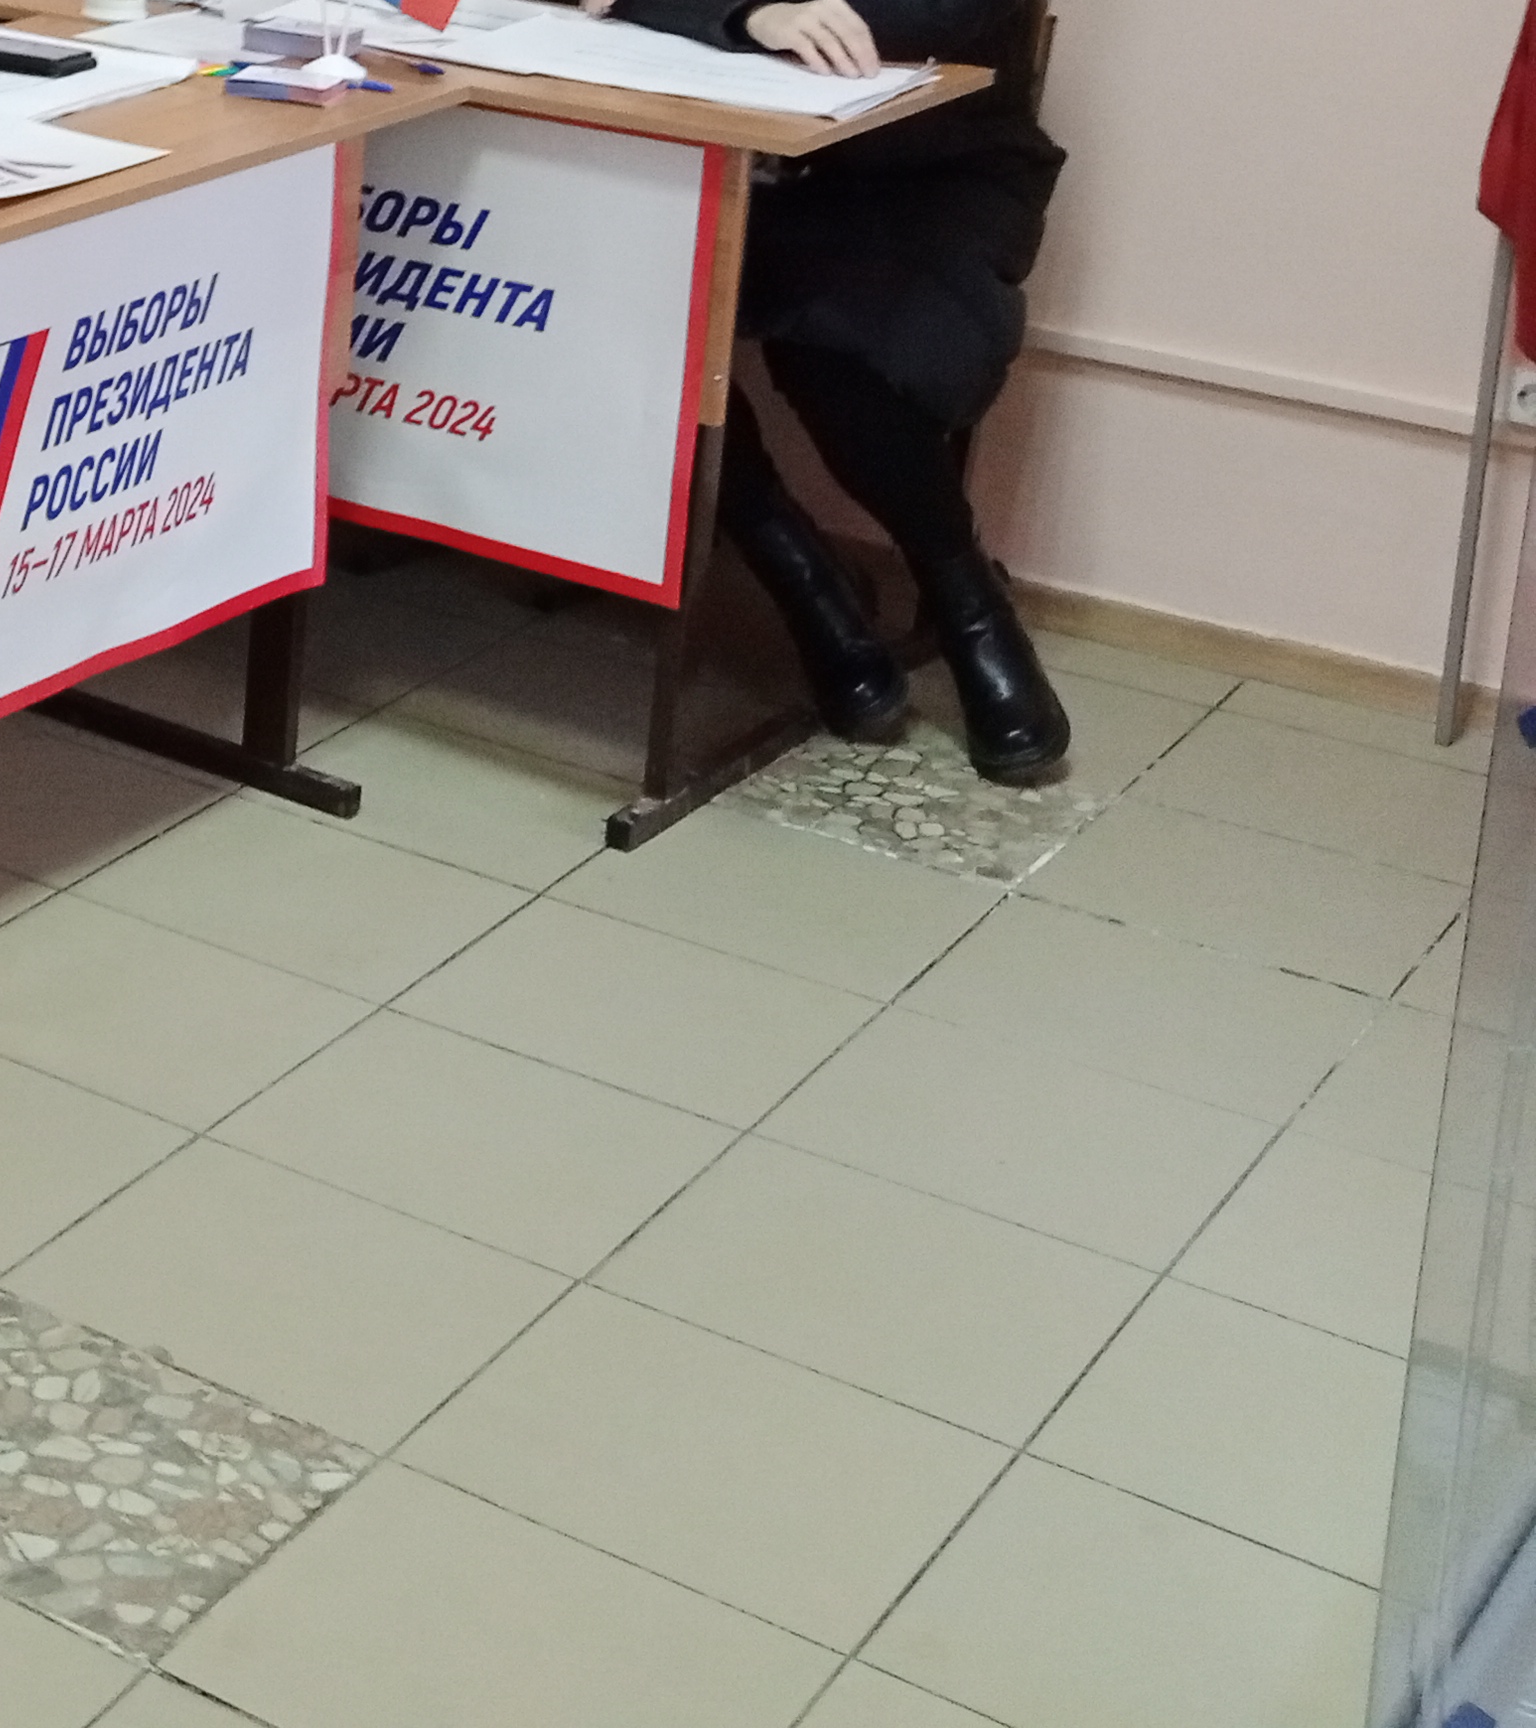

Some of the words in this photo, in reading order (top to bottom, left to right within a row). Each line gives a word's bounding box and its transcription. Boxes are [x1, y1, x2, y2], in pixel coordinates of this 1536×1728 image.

[62, 272, 220, 373] ВЫБОРЫ
[41, 327, 254, 452] ПРЕЗИДЕНТА
[403, 389, 496, 442] 2024
[20, 428, 165, 532] РОССИИ
[73, 495, 161, 571] МАРТА
[160, 471, 215, 535] 2024
